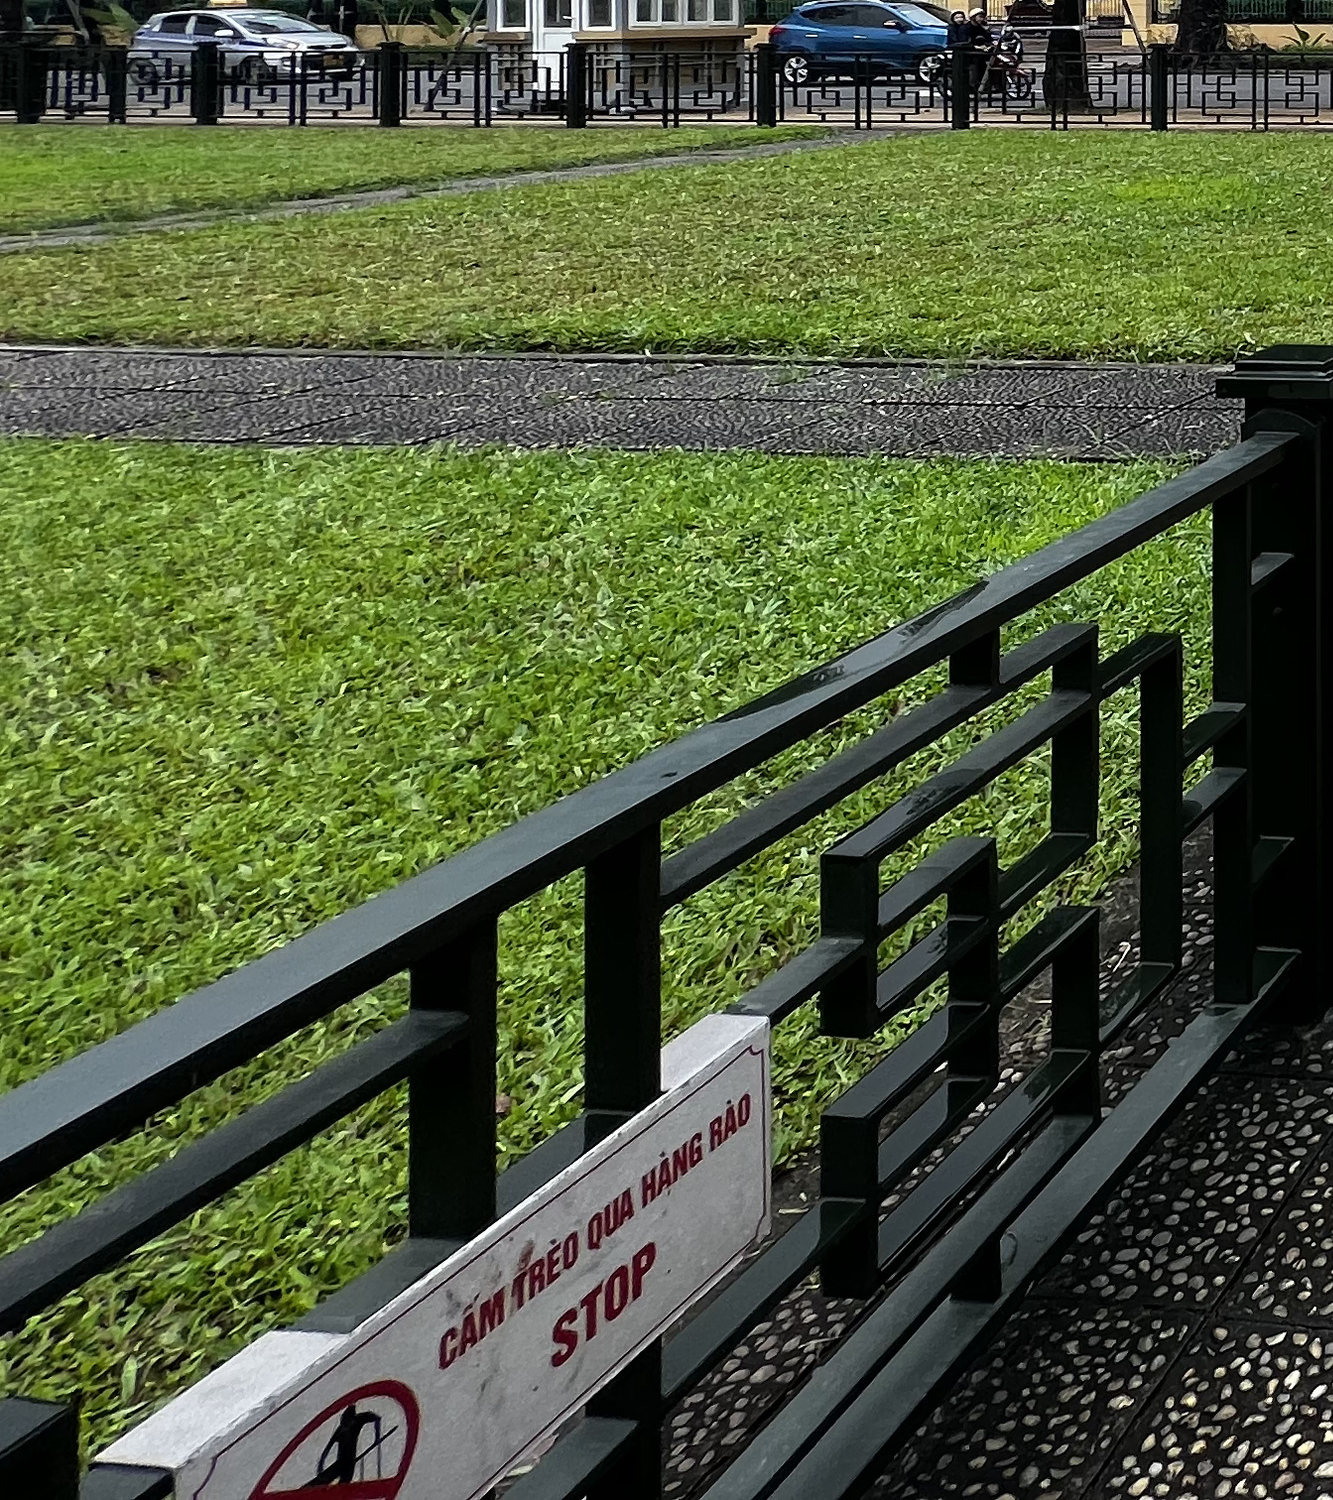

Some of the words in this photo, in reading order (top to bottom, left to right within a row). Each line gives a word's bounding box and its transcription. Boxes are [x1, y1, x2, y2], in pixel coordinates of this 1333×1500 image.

[588, 1187, 634, 1250] QUA
[641, 1132, 703, 1208] HÀNG
[551, 1241, 656, 1368] STOP
